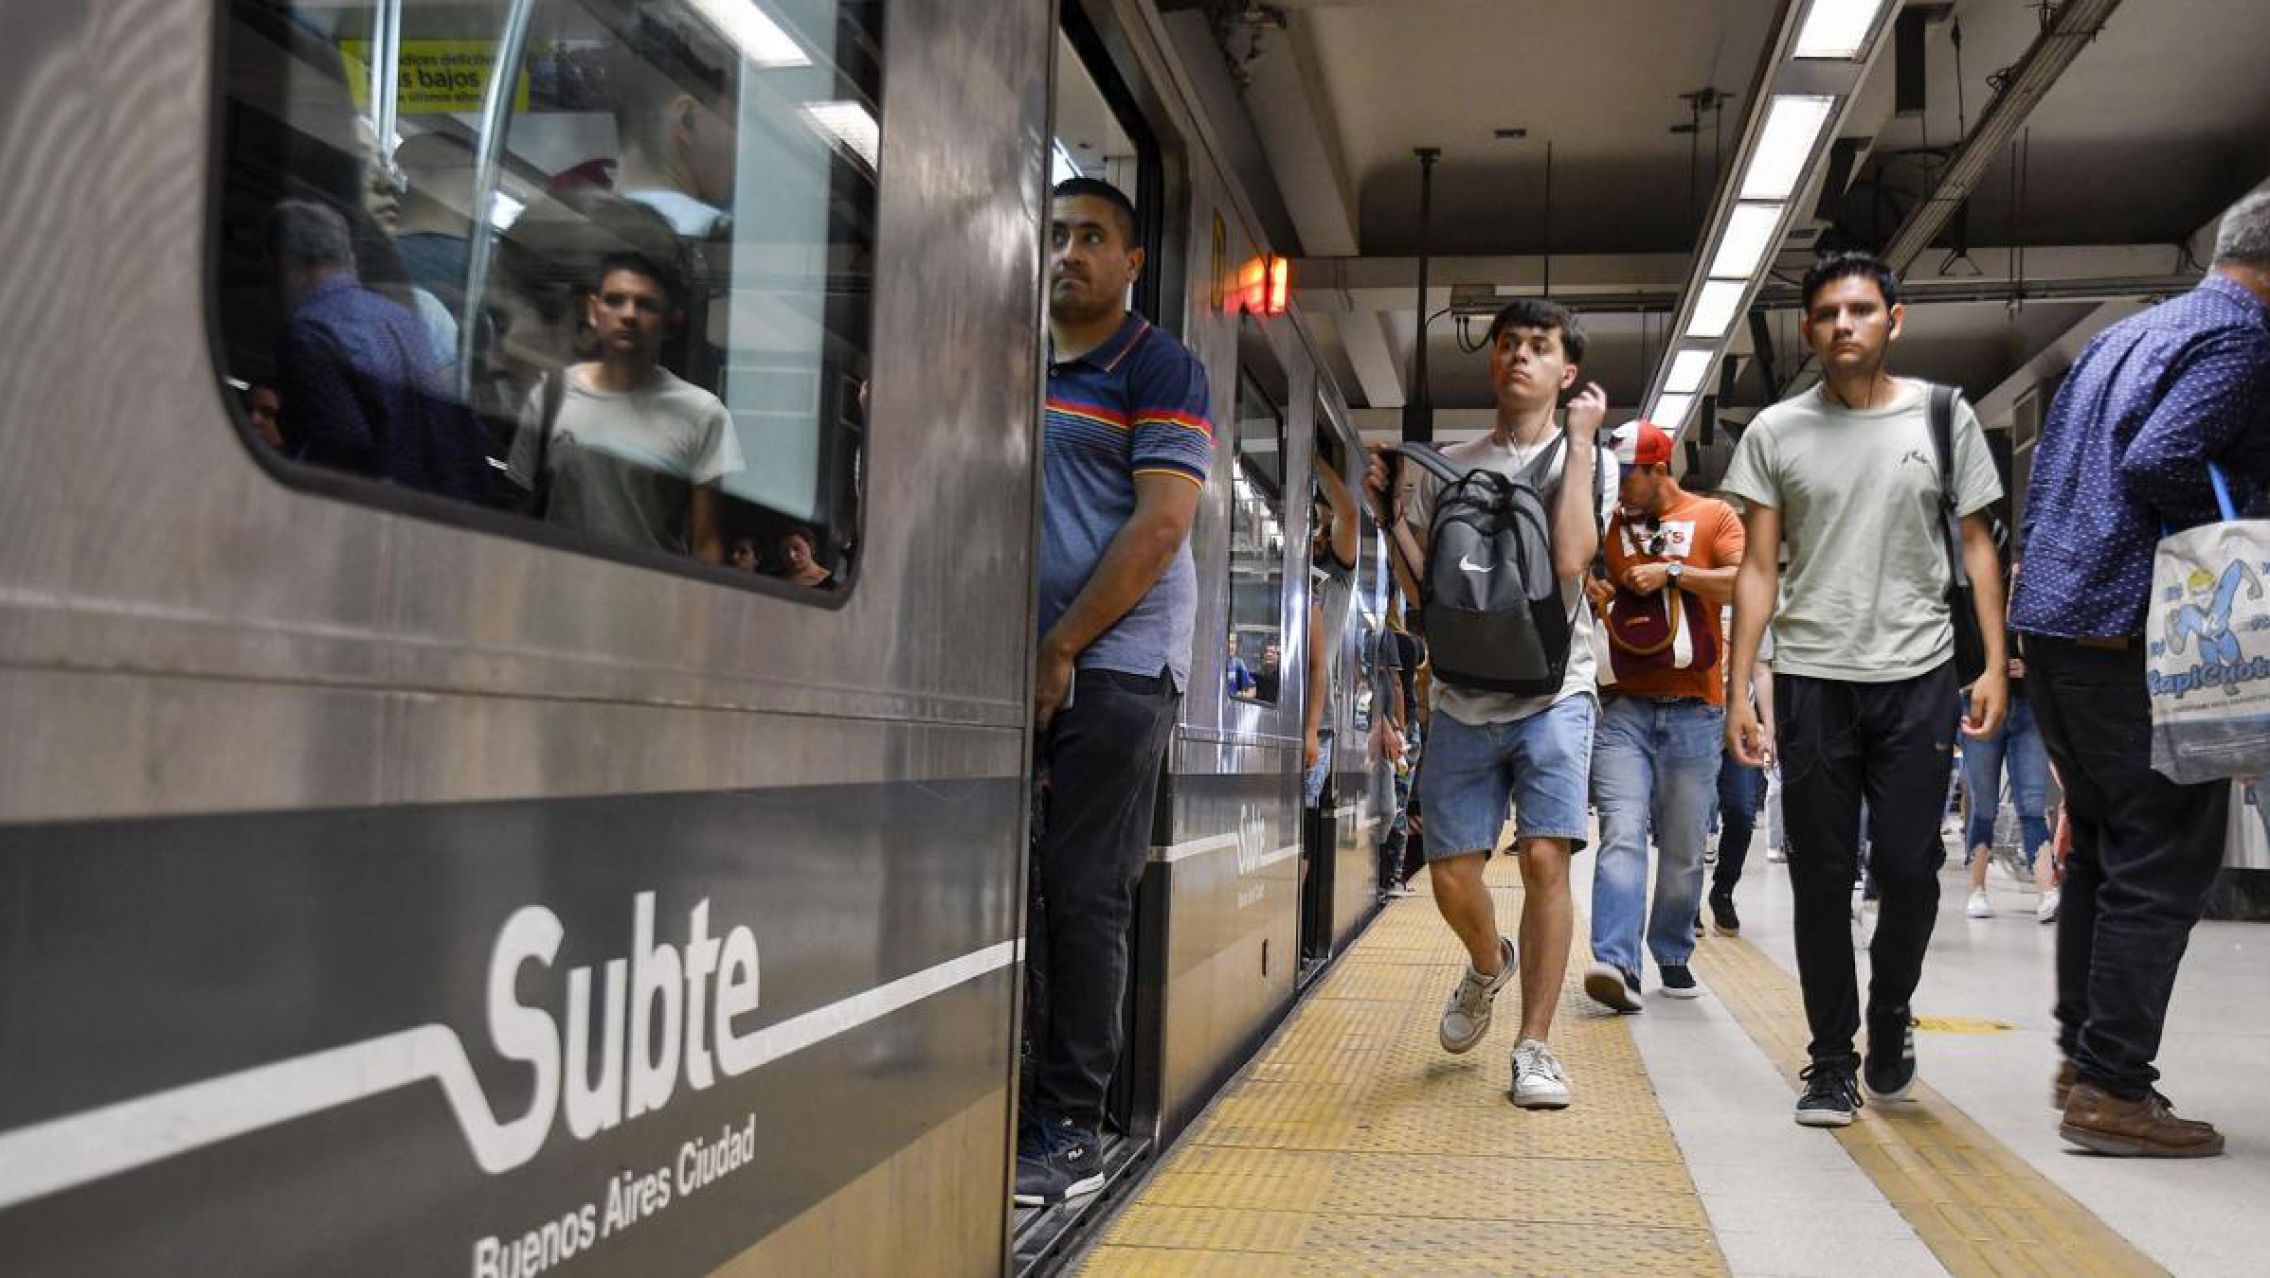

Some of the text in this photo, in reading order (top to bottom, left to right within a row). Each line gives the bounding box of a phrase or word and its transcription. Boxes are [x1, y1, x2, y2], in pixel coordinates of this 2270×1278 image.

[417, 68, 480, 91] bajos
[482, 890, 760, 1175] Subte
[473, 1112, 756, 1278] Buenos Aires Ciudad
